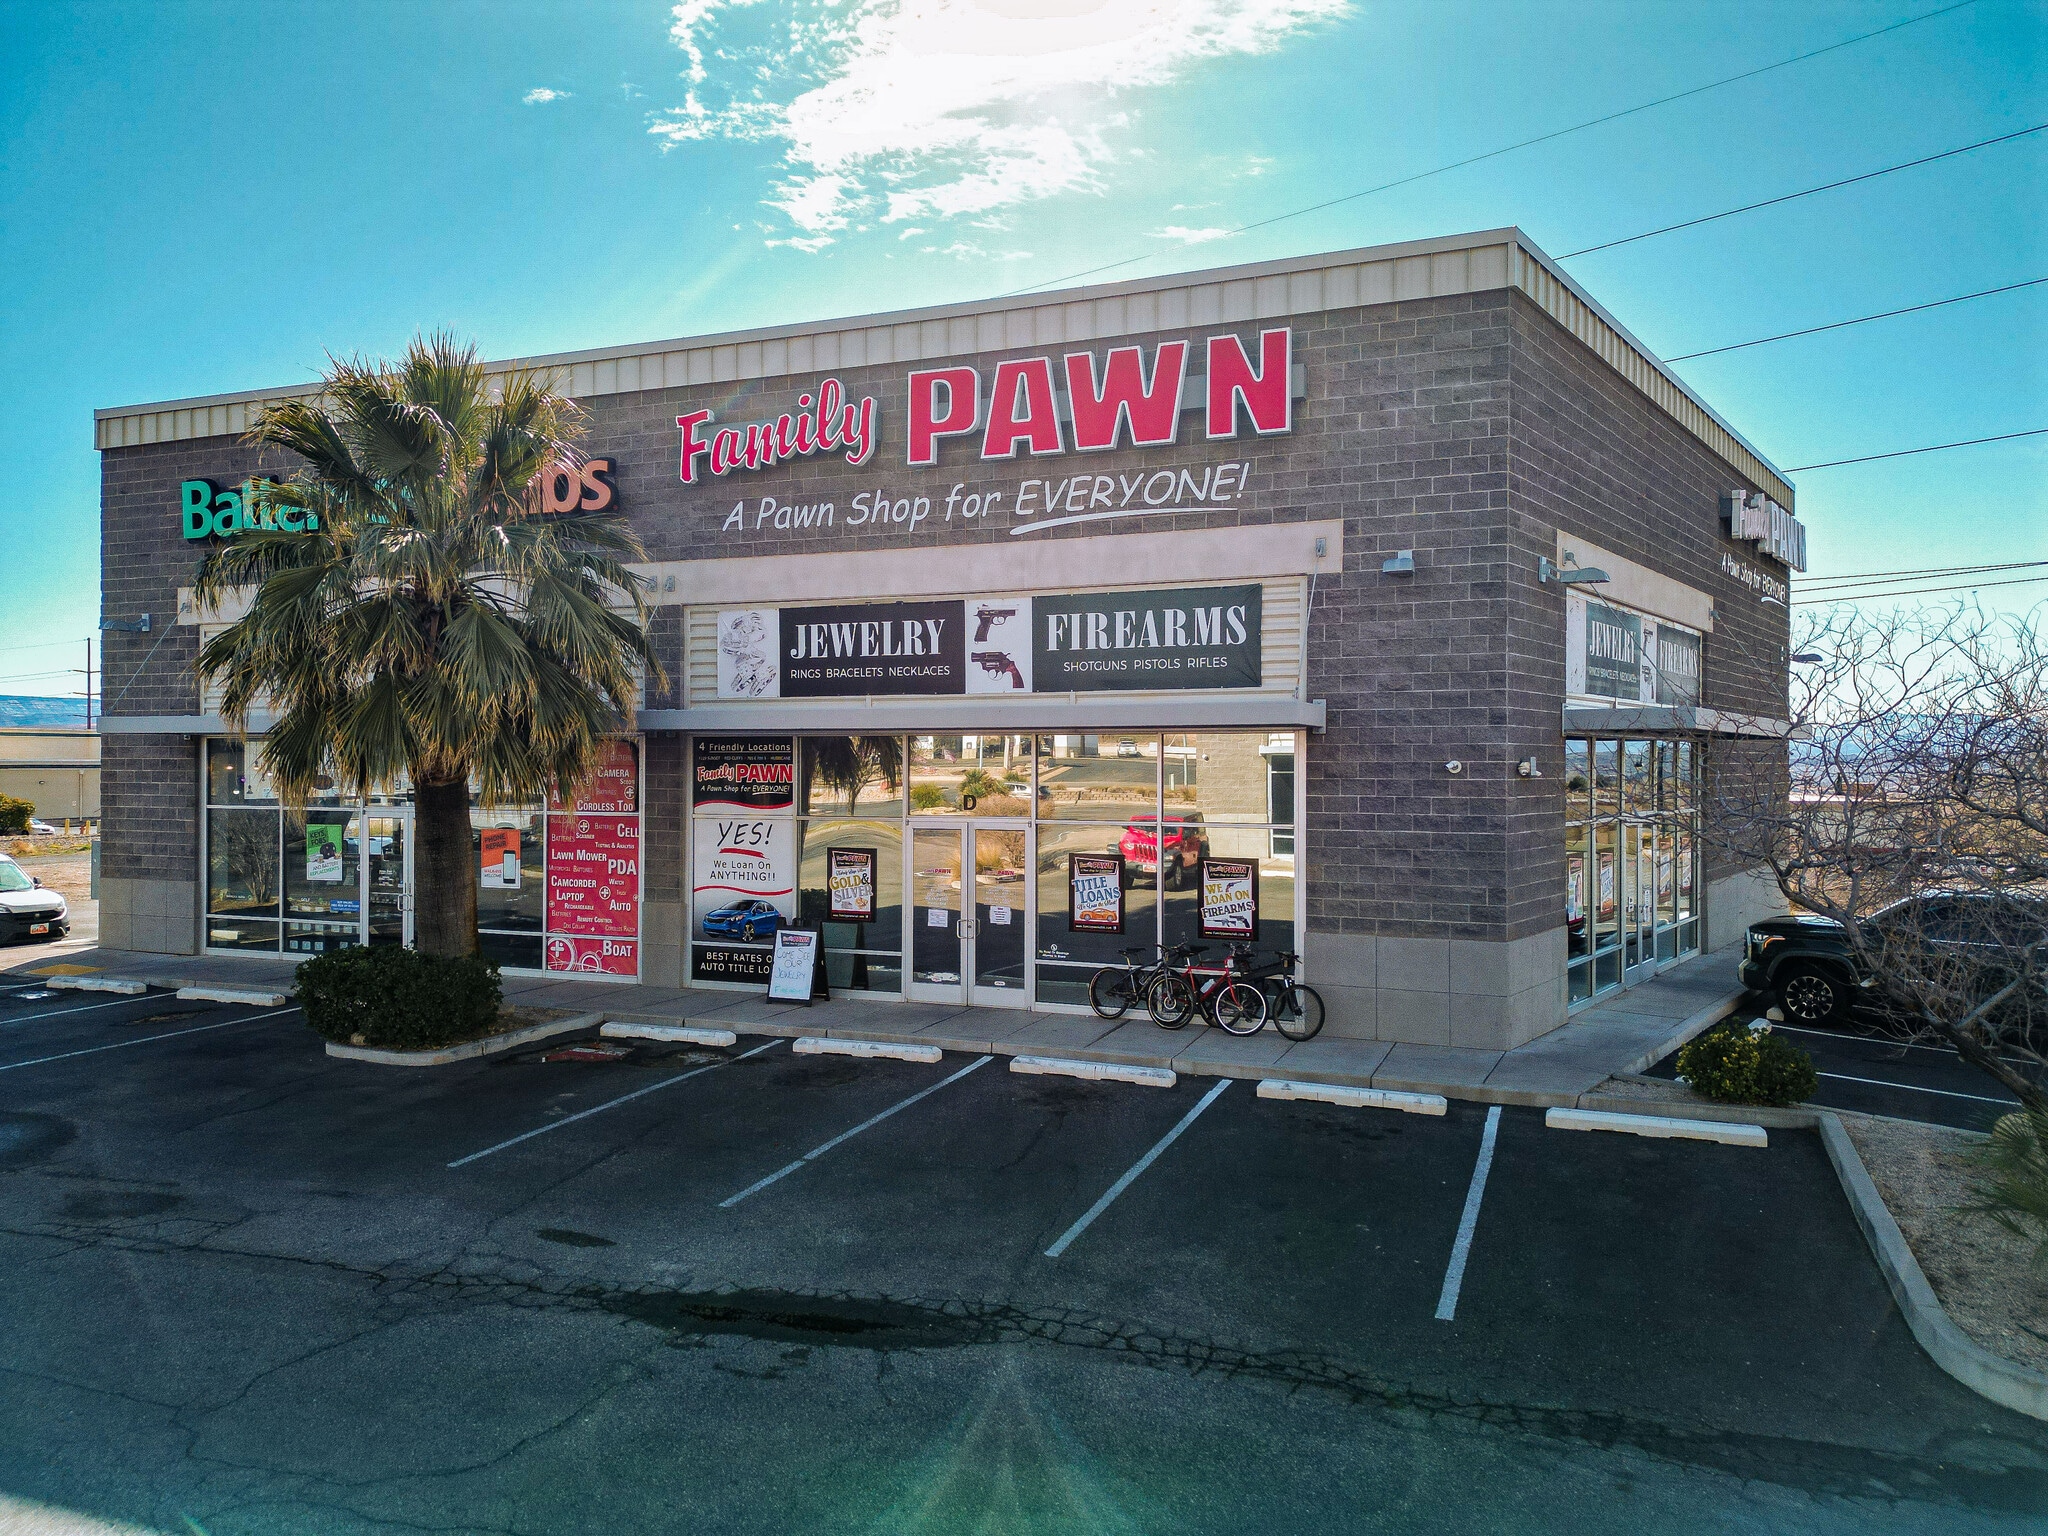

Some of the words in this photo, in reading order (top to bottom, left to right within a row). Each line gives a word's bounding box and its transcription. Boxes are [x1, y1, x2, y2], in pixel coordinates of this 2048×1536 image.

[676, 378, 877, 484] Family
[906, 326, 1293, 466] PAWN
[722, 499, 744, 532] A
[757, 496, 834, 530] Pawn
[846, 490, 931, 532] Shop
[944, 482, 1001, 521] for
[1015, 462, 1250, 516] EVERYONE!
[790, 618, 945, 660] JEWELRY
[1045, 604, 1248, 652] FIREARMS
[1590, 620, 1636, 664] JEWELRY
[790, 668, 822, 679] RINGS
[826, 666, 883, 679] BRACELETS
[889, 664, 950, 677] NECKLACES
[1063, 659, 1127, 672] SHOTGUNS
[1133, 657, 1181, 671] PISTOLS
[1187, 656, 1228, 669] RIFLES
[699, 742, 706, 751] 4
[709, 743, 745, 752] Friendly
[748, 743, 791, 752] Locations
[597, 766, 630, 778] CAMERA
[697, 763, 734, 782] Family
[736, 764, 794, 783] PAWN
[752, 784, 790, 793] EVERYONE!
[577, 800, 614, 812] CORDLESS
[964, 794, 976, 810] D
[617, 823, 639, 838] CELL
[716, 820, 773, 847] YES!
[552, 848, 574, 860] LAWN
[576, 849, 607, 862] MOWER
[608, 858, 636, 875] PDA
[714, 860, 727, 868] We
[731, 860, 754, 869] Loan
[758, 861, 771, 870] On
[551, 875, 596, 888] CAMCORDER
[710, 870, 776, 882] ANYTHING!!
[830, 875, 860, 890] GOLD
[862, 872, 870, 884] &
[1073, 876, 1108, 892] TITLE
[556, 889, 584, 902] LAPTOP
[834, 884, 873, 904] SILVER
[1080, 886, 1120, 904] LOANS
[1205, 884, 1223, 894] WE
[609, 899, 631, 912] AUTO
[1205, 892, 1233, 906] LOAN
[1234, 890, 1250, 901] ON
[1202, 900, 1256, 919] FIREARMS!
[602, 940, 632, 957] BOAT
[706, 952, 730, 960] BEST
[733, 953, 762, 963] RATES
[766, 955, 772, 963] O
[700, 962, 725, 972] AUTO
[728, 963, 754, 973] TITLE
